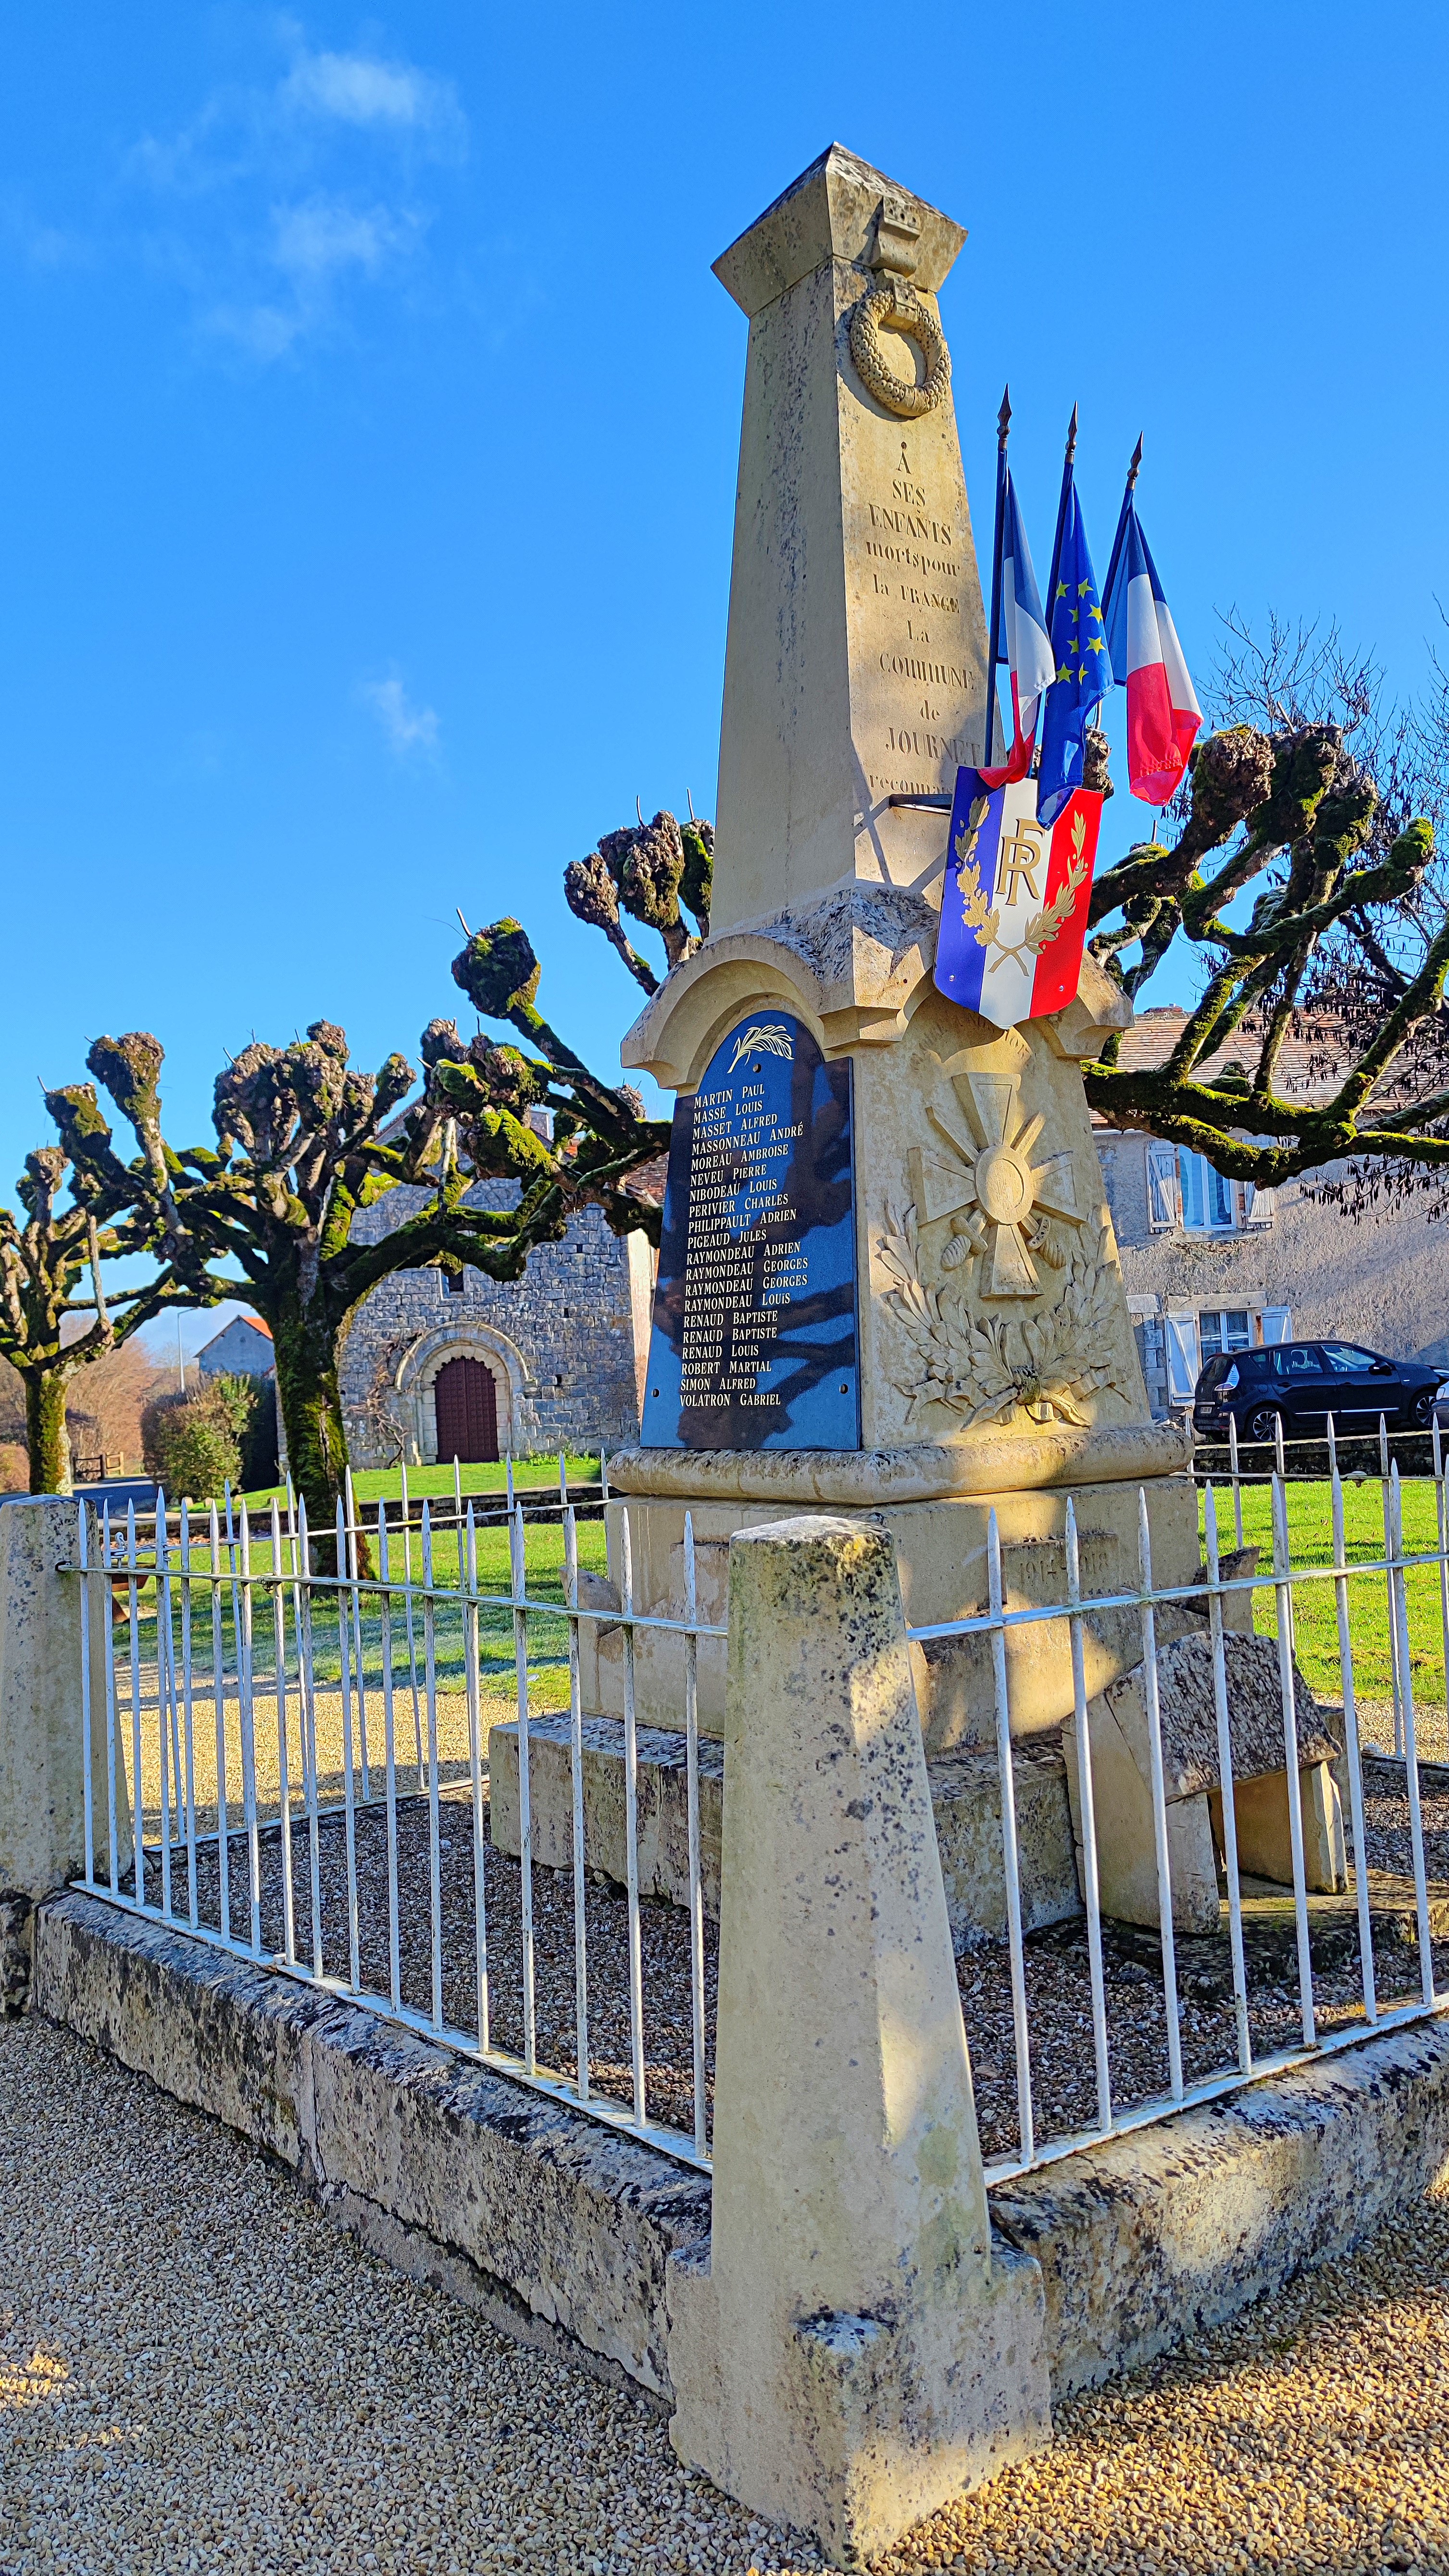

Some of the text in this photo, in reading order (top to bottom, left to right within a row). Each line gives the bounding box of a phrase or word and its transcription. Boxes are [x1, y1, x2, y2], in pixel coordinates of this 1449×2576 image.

[892, 479, 926, 507] SES
[867, 503, 952, 547] ENFANTS
[873, 573, 890, 596] la
[878, 653, 975, 690] COMMUNE
[920, 699, 941, 721] de
[885, 726, 981, 767] JOURNET
[694, 1084, 765, 1109] MARTIN PAUL
[693, 1100, 762, 1125] MASSE LOUIS
[691, 1121, 803, 1156] MASSONNEAU ANDRÉ
[692, 1113, 777, 1140] MASSET ALFRED
[691, 1144, 788, 1172] MOREAU AMBROISE
[690, 1164, 767, 1187] NEVEU PIERRE
[689, 1178, 777, 1202] NIBODEAU LOUIS
[688, 1193, 788, 1218] PERIVIER CHARLES
[688, 1208, 797, 1234] PHILIPPAULT ADRIEN
[687, 1229, 766, 1250] PIGEAUD JULES
[686, 1241, 801, 1265] RAYMONDEAU ADRIEN
[686, 1257, 808, 1281] RAYMONDEAU GEORGES
[685, 1274, 807, 1297] RAYMONDEAU GEORGES
[685, 1292, 790, 1312] RAYMONDEAU LOUIS
[683, 1310, 778, 1328] RENAUD BAPTISTE
[683, 1327, 777, 1344] RENAUD BAPTISTE
[682, 1345, 759, 1360] RENAUD LOUIS
[681, 1361, 772, 1376] ROBERT MARTIAL
[680, 1377, 756, 1391] SIMON ALFRED
[679, 1393, 781, 1407] VOLATRON GABRIEL
